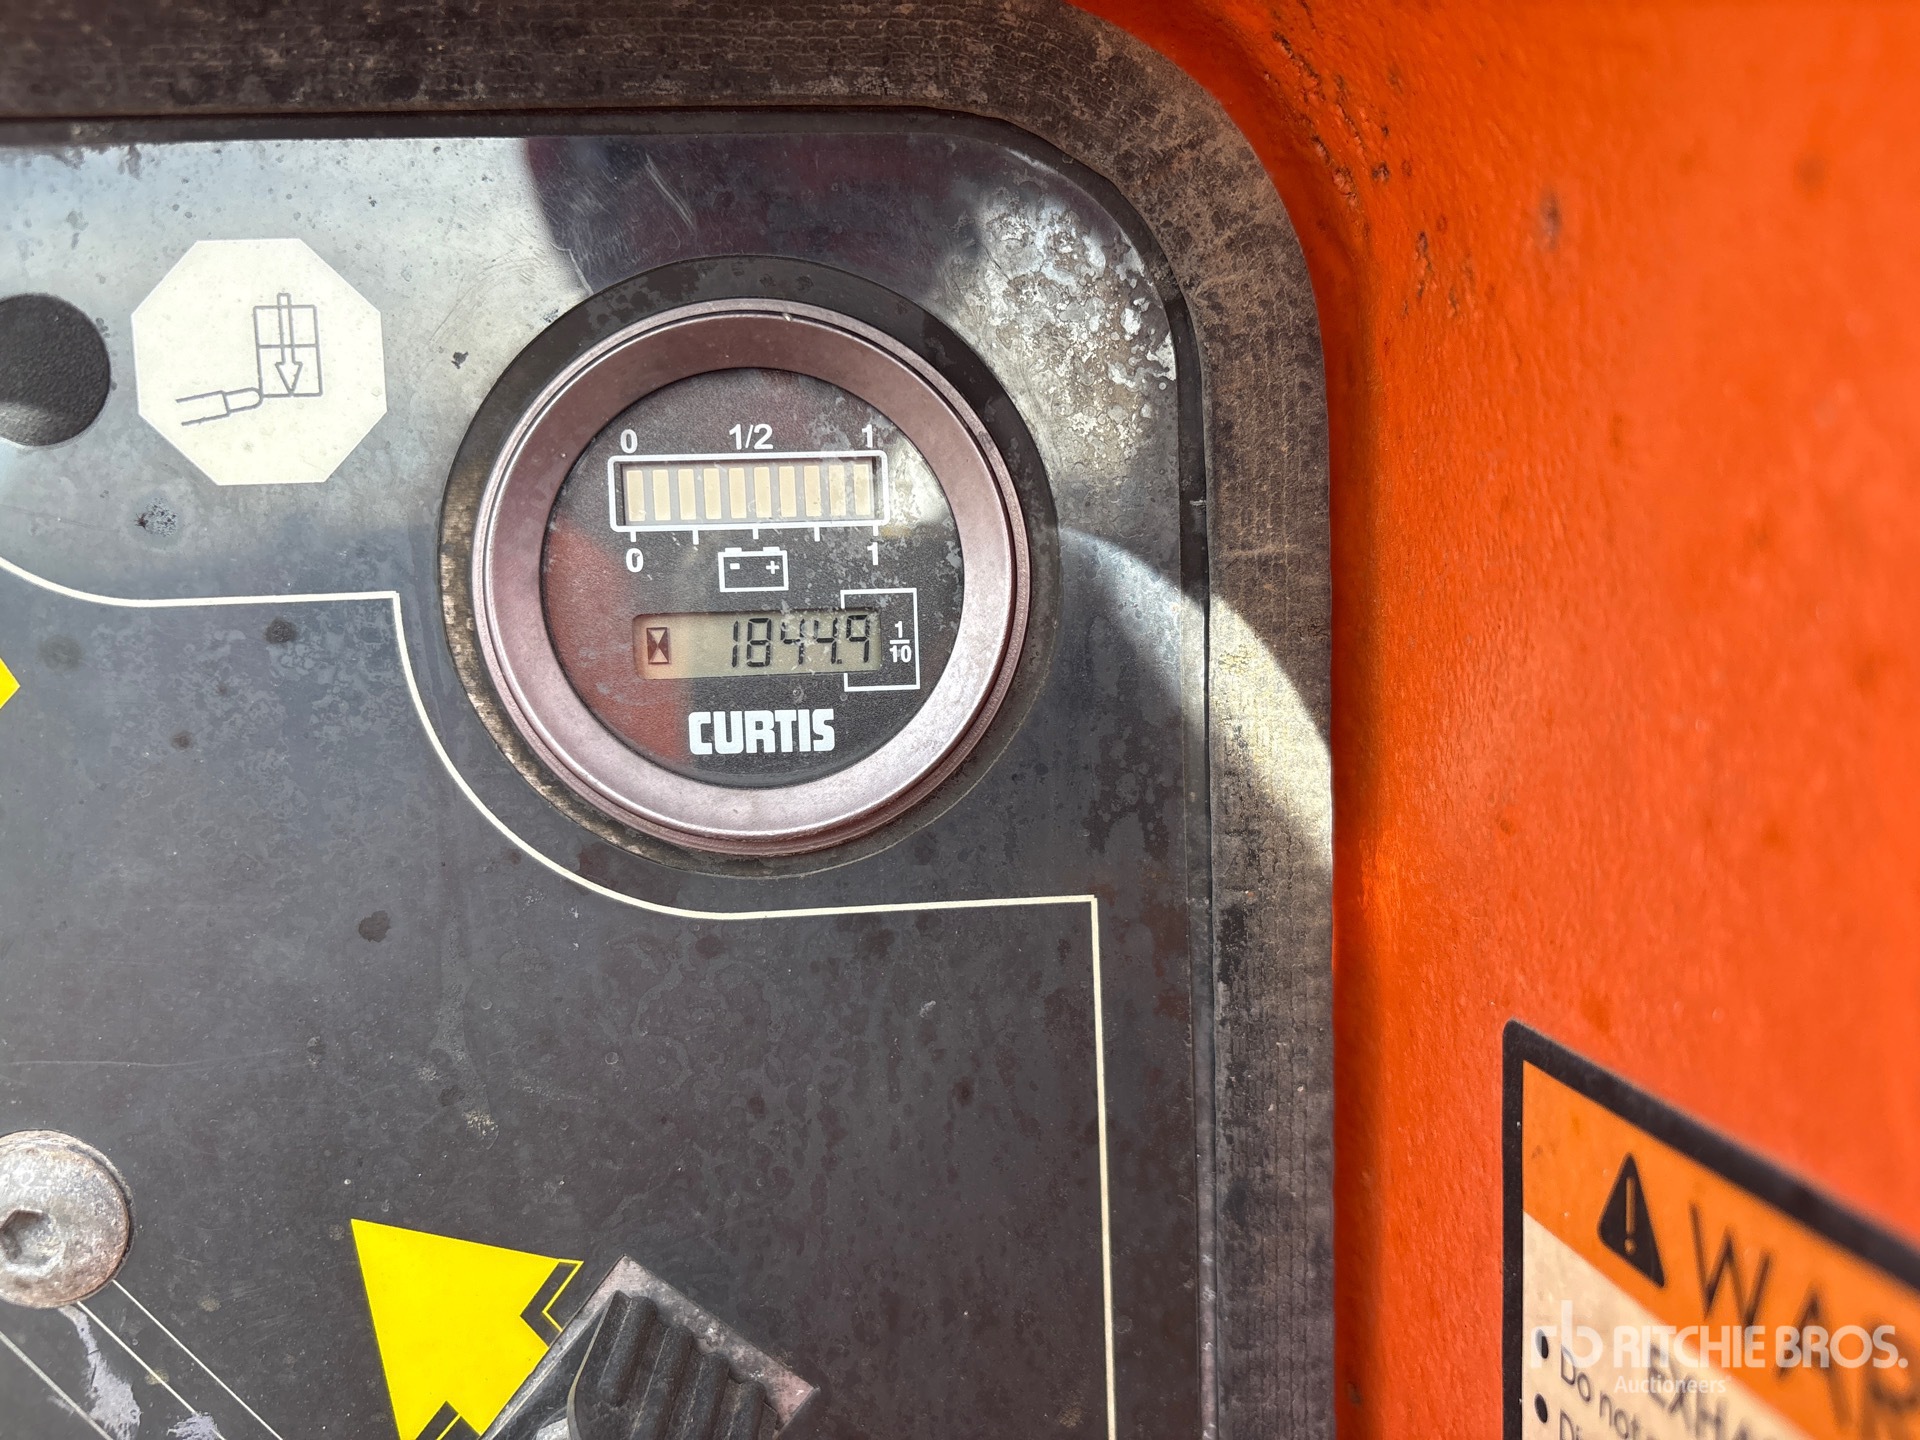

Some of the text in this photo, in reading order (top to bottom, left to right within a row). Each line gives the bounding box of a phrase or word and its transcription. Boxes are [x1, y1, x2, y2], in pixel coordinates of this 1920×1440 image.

[620, 423, 874, 453] 0 1/2 1
[626, 541, 879, 573] 0 1
[731, 614, 870, 668] 1844.9
[688, 708, 836, 755] CURTIS
[1560, 1344, 1592, 1402] Do
